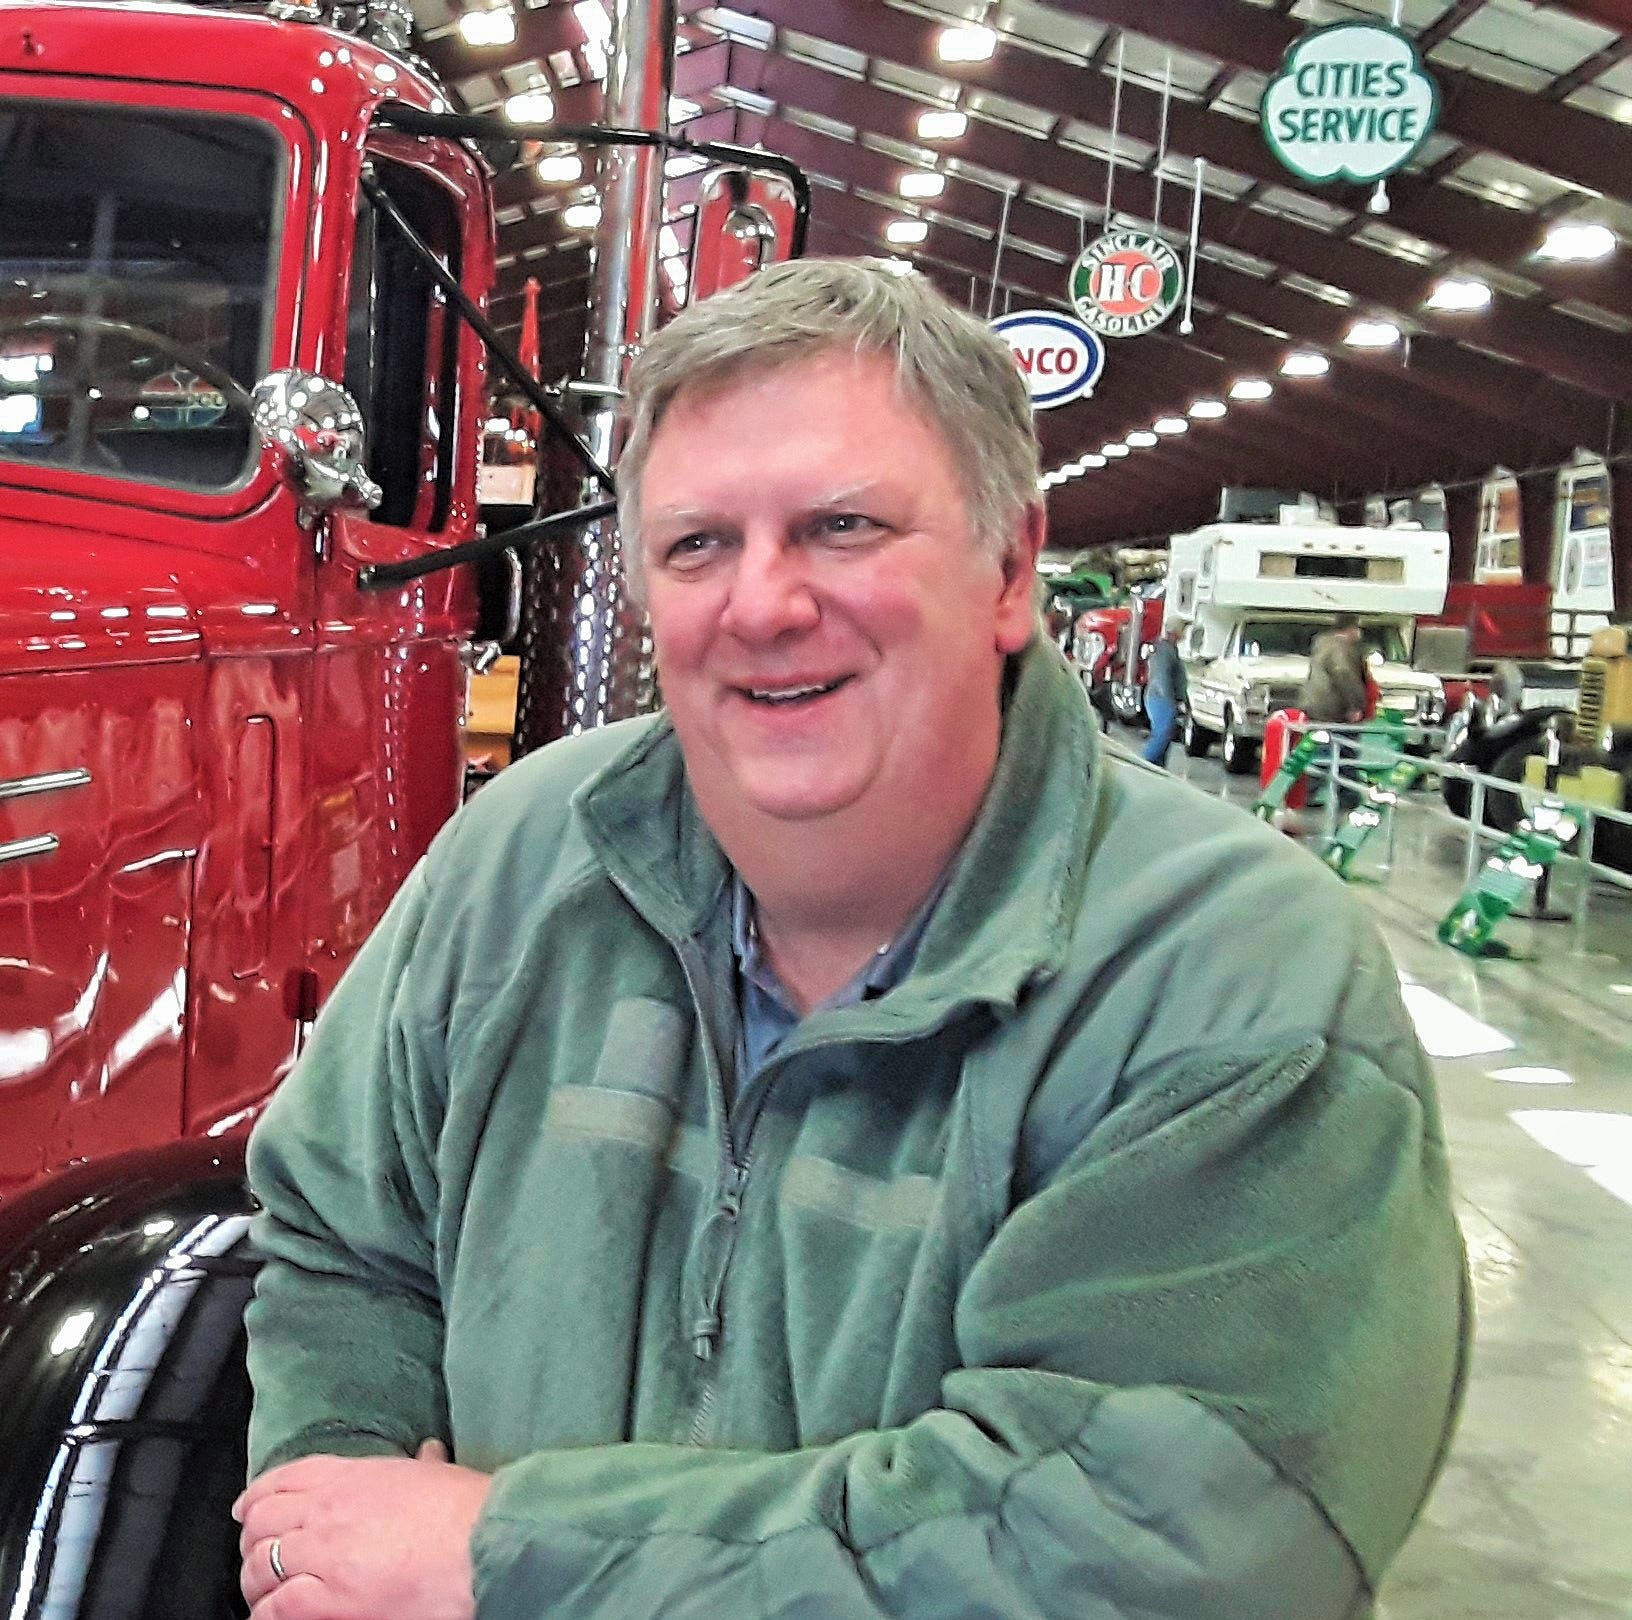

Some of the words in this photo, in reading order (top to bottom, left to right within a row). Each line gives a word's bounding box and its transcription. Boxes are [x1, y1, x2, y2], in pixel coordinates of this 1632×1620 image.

[1296, 61, 1409, 98] CITIES
[1278, 107, 1418, 143] SERVICE
[1080, 234, 1175, 271] SINCLAIR
[1011, 347, 1078, 376] NCO
